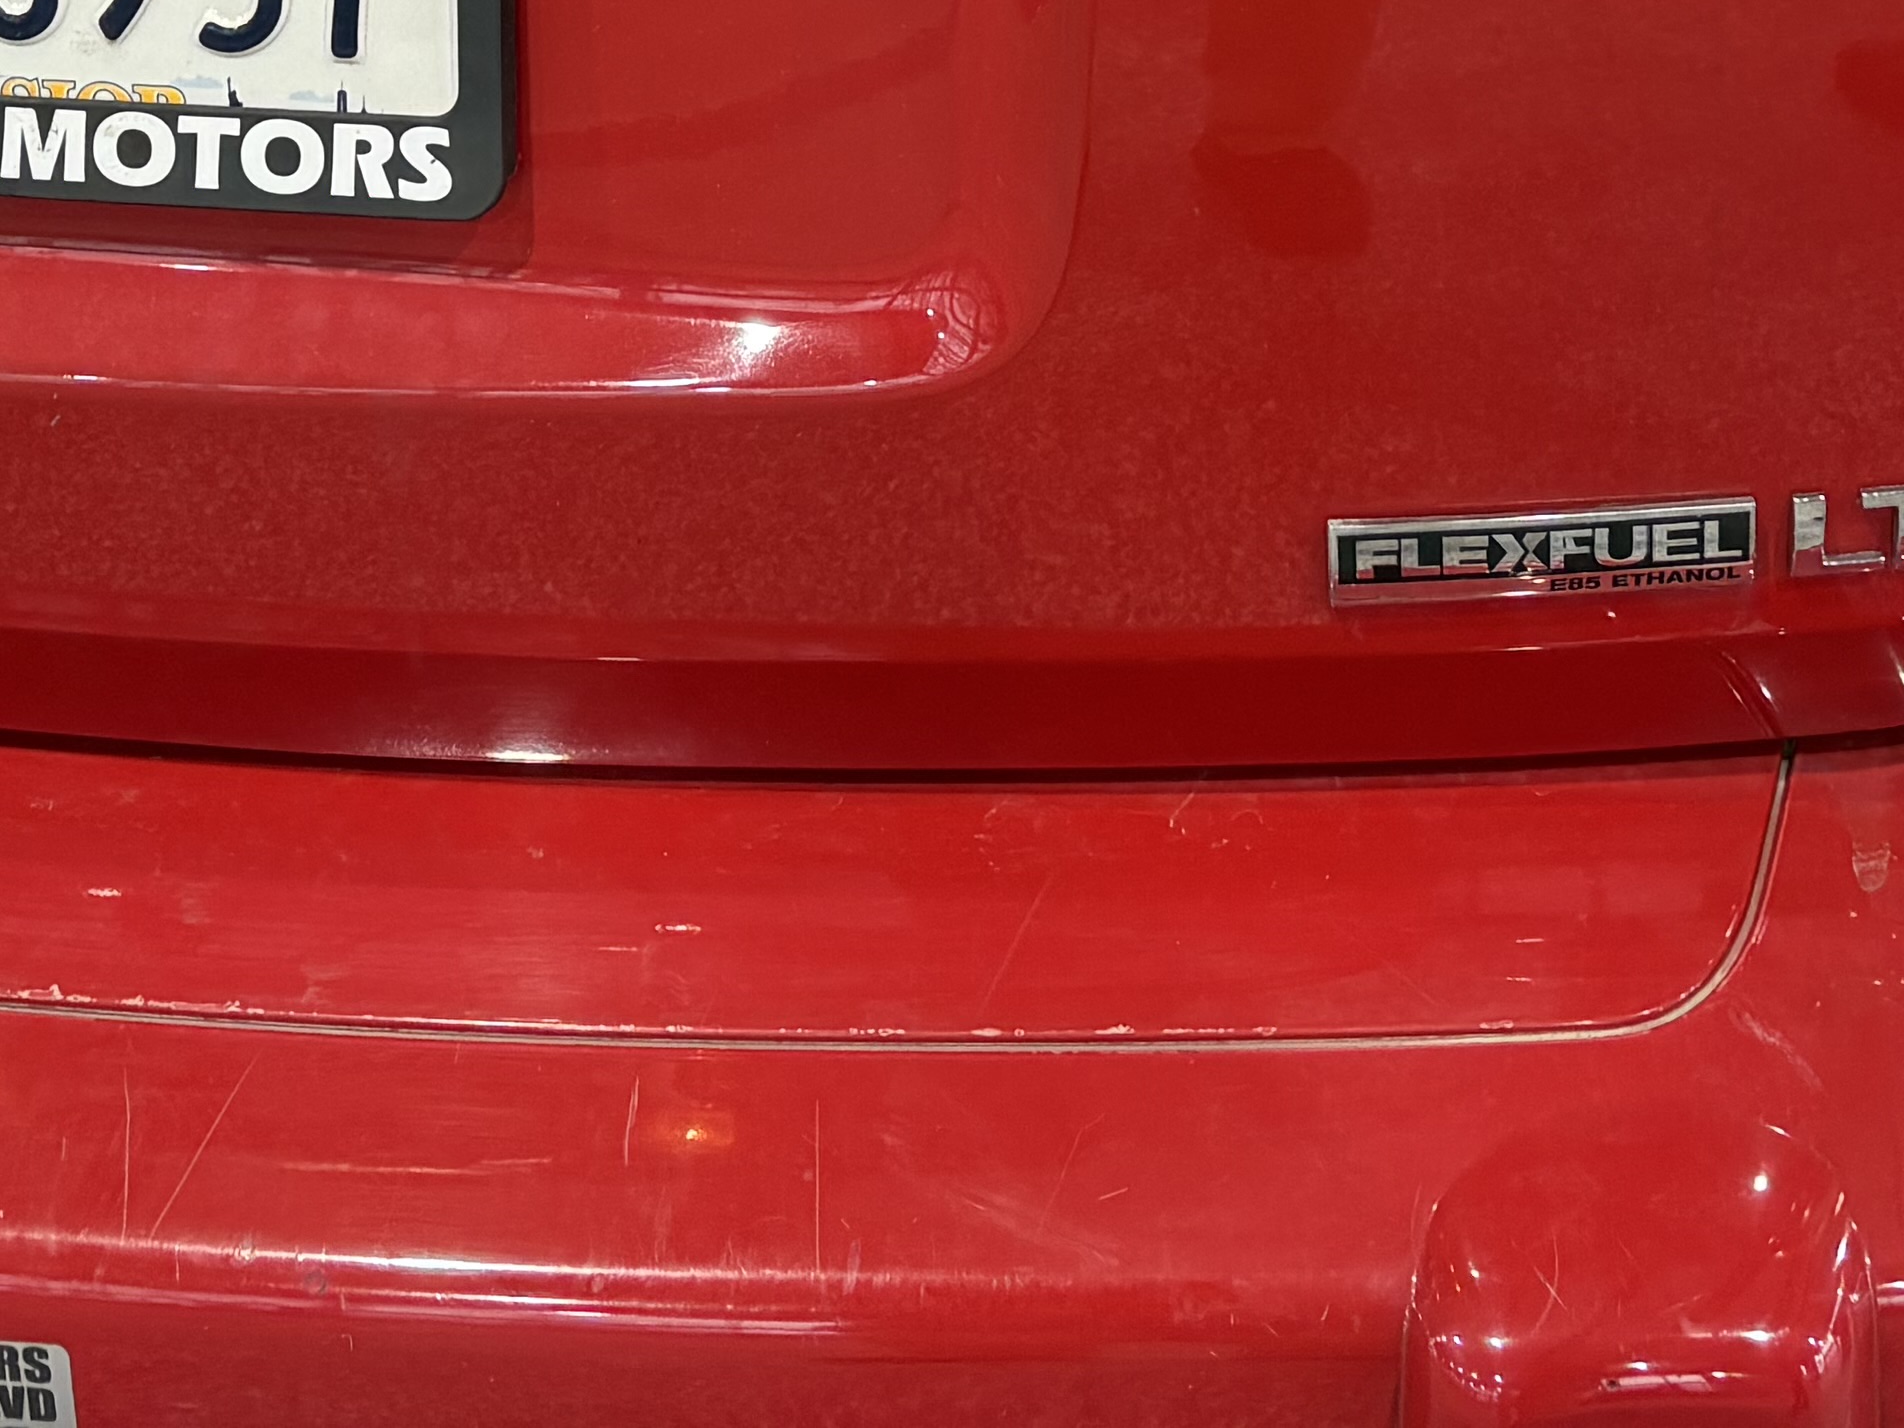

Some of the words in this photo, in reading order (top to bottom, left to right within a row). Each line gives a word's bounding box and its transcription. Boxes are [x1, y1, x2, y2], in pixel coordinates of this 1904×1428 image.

[0, 105, 454, 204] MOTORS
[1354, 519, 1744, 581] FLEXFUEL
[1549, 575, 1601, 592] E85
[1611, 566, 1741, 588] ETHANOL
